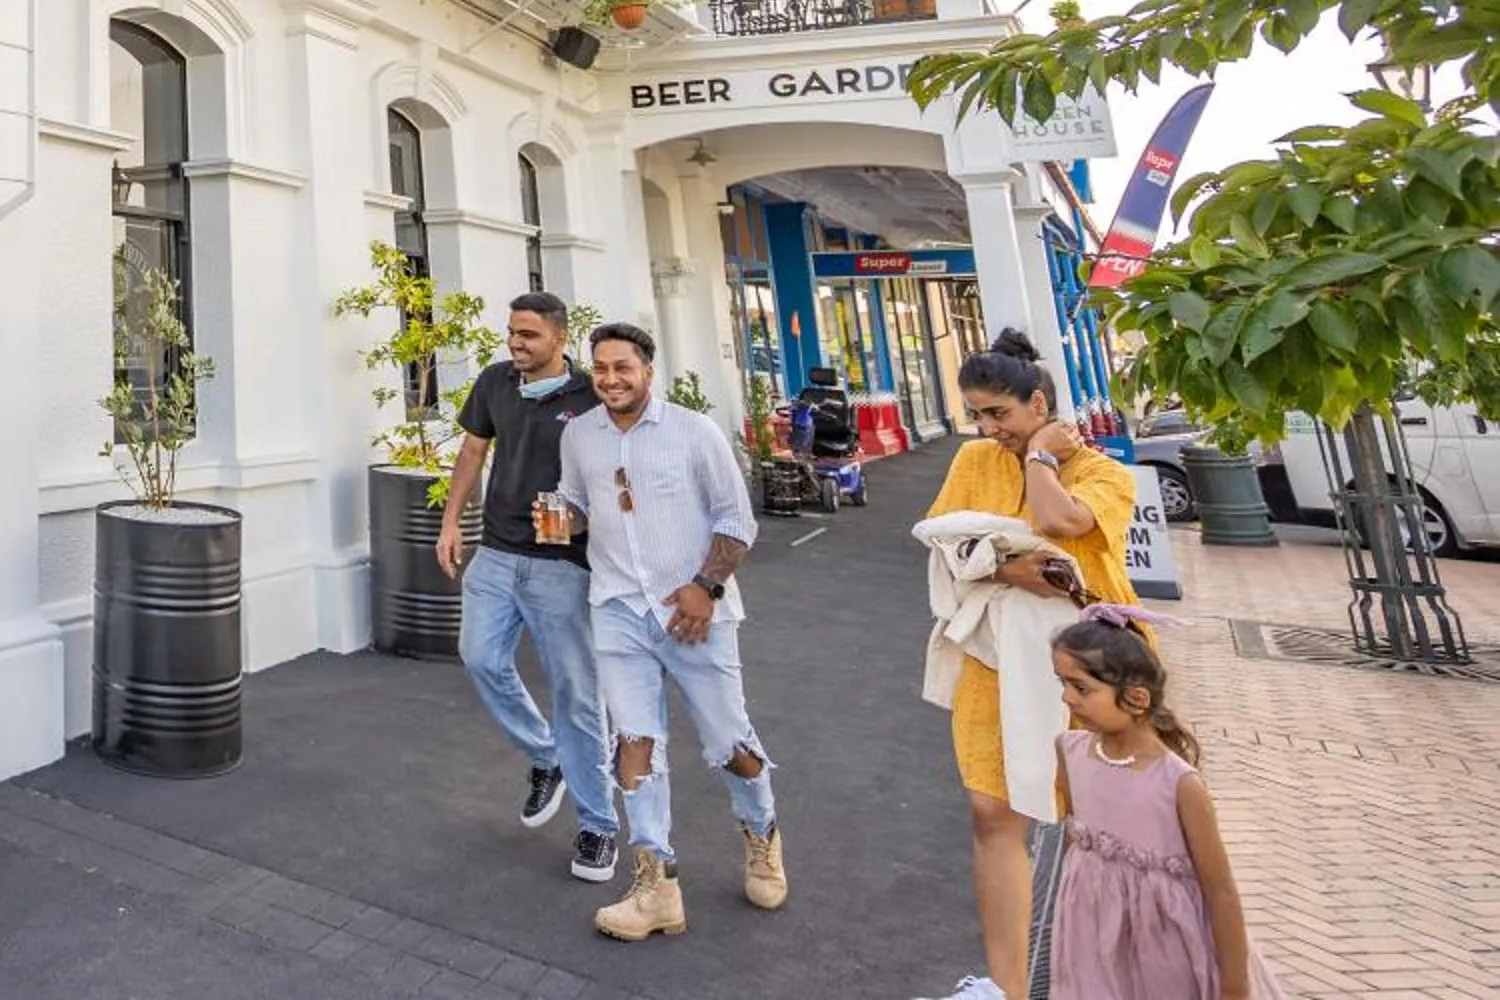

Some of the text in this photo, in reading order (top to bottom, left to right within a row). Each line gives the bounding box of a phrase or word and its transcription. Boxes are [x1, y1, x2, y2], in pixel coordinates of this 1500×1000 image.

[631, 63, 912, 109] BEER GARD
[1012, 120, 1105, 138] HOUSE
[860, 256, 906, 269] Super
